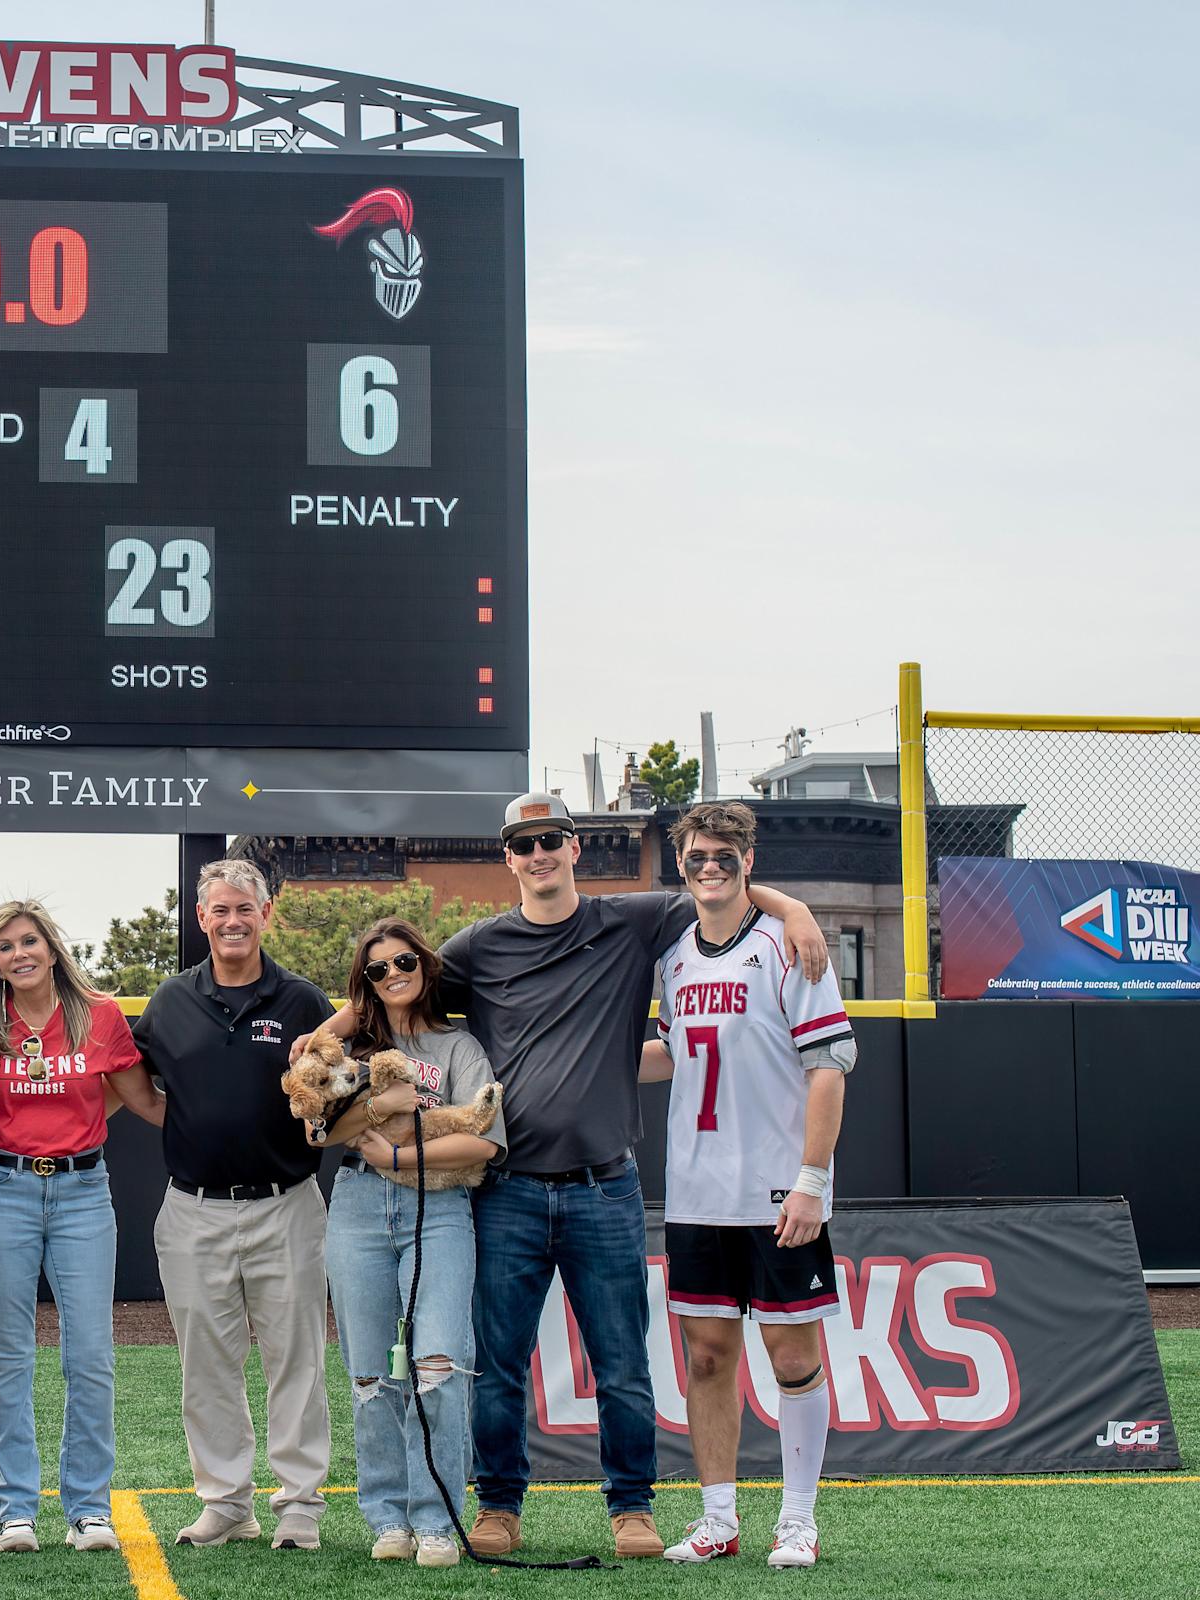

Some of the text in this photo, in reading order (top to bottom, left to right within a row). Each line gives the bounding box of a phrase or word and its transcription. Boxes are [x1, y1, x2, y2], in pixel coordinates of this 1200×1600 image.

[106, 125, 307, 154] COMPLEX
[339, 354, 400, 456] 6
[64, 398, 113, 475] 4
[290, 494, 459, 526] PENALTY
[106, 538, 212, 626] 23
[110, 665, 208, 688] SHOTS
[1126, 905, 1189, 942] DIII
[1129, 940, 1189, 964] WEEK
[988, 978, 1039, 990] Celebrating
[1041, 979, 1083, 989] academic
[1084, 980, 1120, 991] success,
[1122, 979, 1155, 989] athletic
[251, 1019, 283, 1030] STEVENS
[10, 1081, 65, 1095] LACROSSE
[685, 1025, 720, 1132] 7
